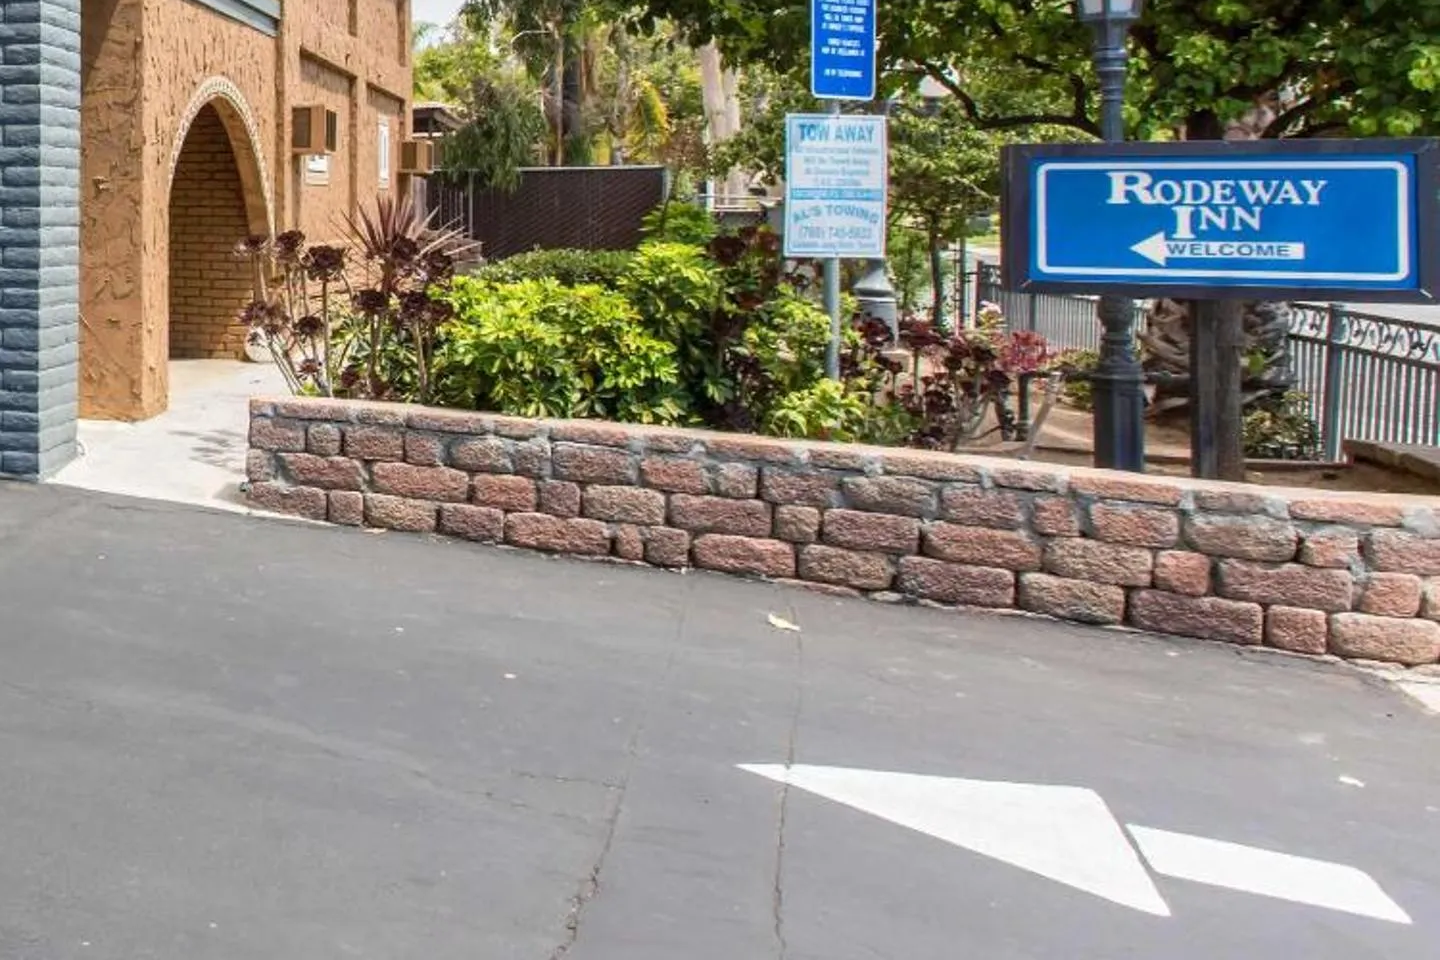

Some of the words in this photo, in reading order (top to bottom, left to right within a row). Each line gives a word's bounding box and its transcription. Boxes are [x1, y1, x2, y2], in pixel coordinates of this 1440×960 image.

[798, 123, 830, 141] TOW
[834, 123, 875, 143] AWAY
[1106, 170, 1327, 206] RODEWAY
[824, 204, 880, 224] TOWING
[1171, 206, 1263, 239] INN
[1166, 243, 1290, 258] WELCOME
